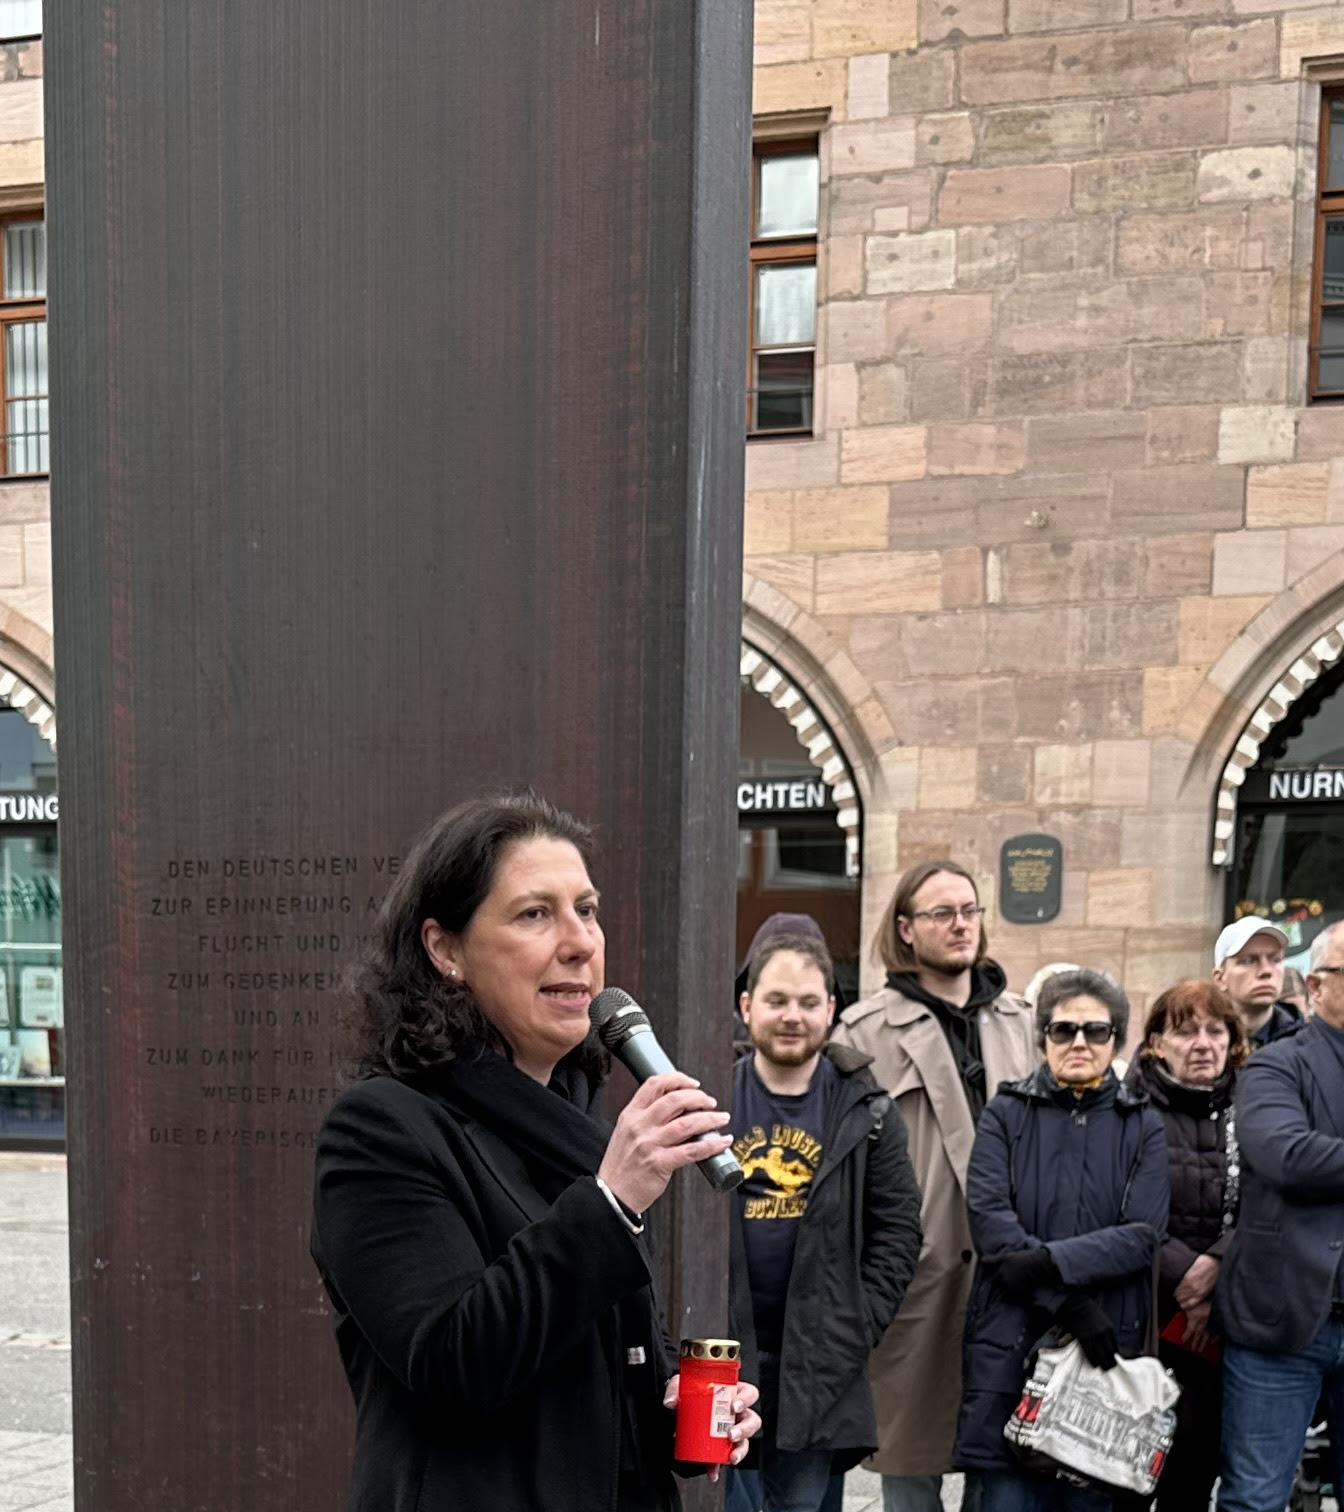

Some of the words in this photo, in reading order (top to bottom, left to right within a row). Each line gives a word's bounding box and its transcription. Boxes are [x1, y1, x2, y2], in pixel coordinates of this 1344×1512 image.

[737, 782, 826, 810] CHTEN
[168, 860, 210, 878] DEN
[223, 856, 358, 878] DEUTSCHEN
[372, 856, 400, 876] VE
[151, 898, 193, 916] ZUR
[198, 934, 284, 953] FLUCHT
[297, 934, 342, 953] UND
[167, 972, 210, 991] ZUM
[233, 1010, 278, 1028] UND
[292, 1010, 320, 1028] AN
[146, 1048, 189, 1066] ZUM
[201, 1048, 258, 1067] DANK
[149, 1127, 183, 1145] DIE
